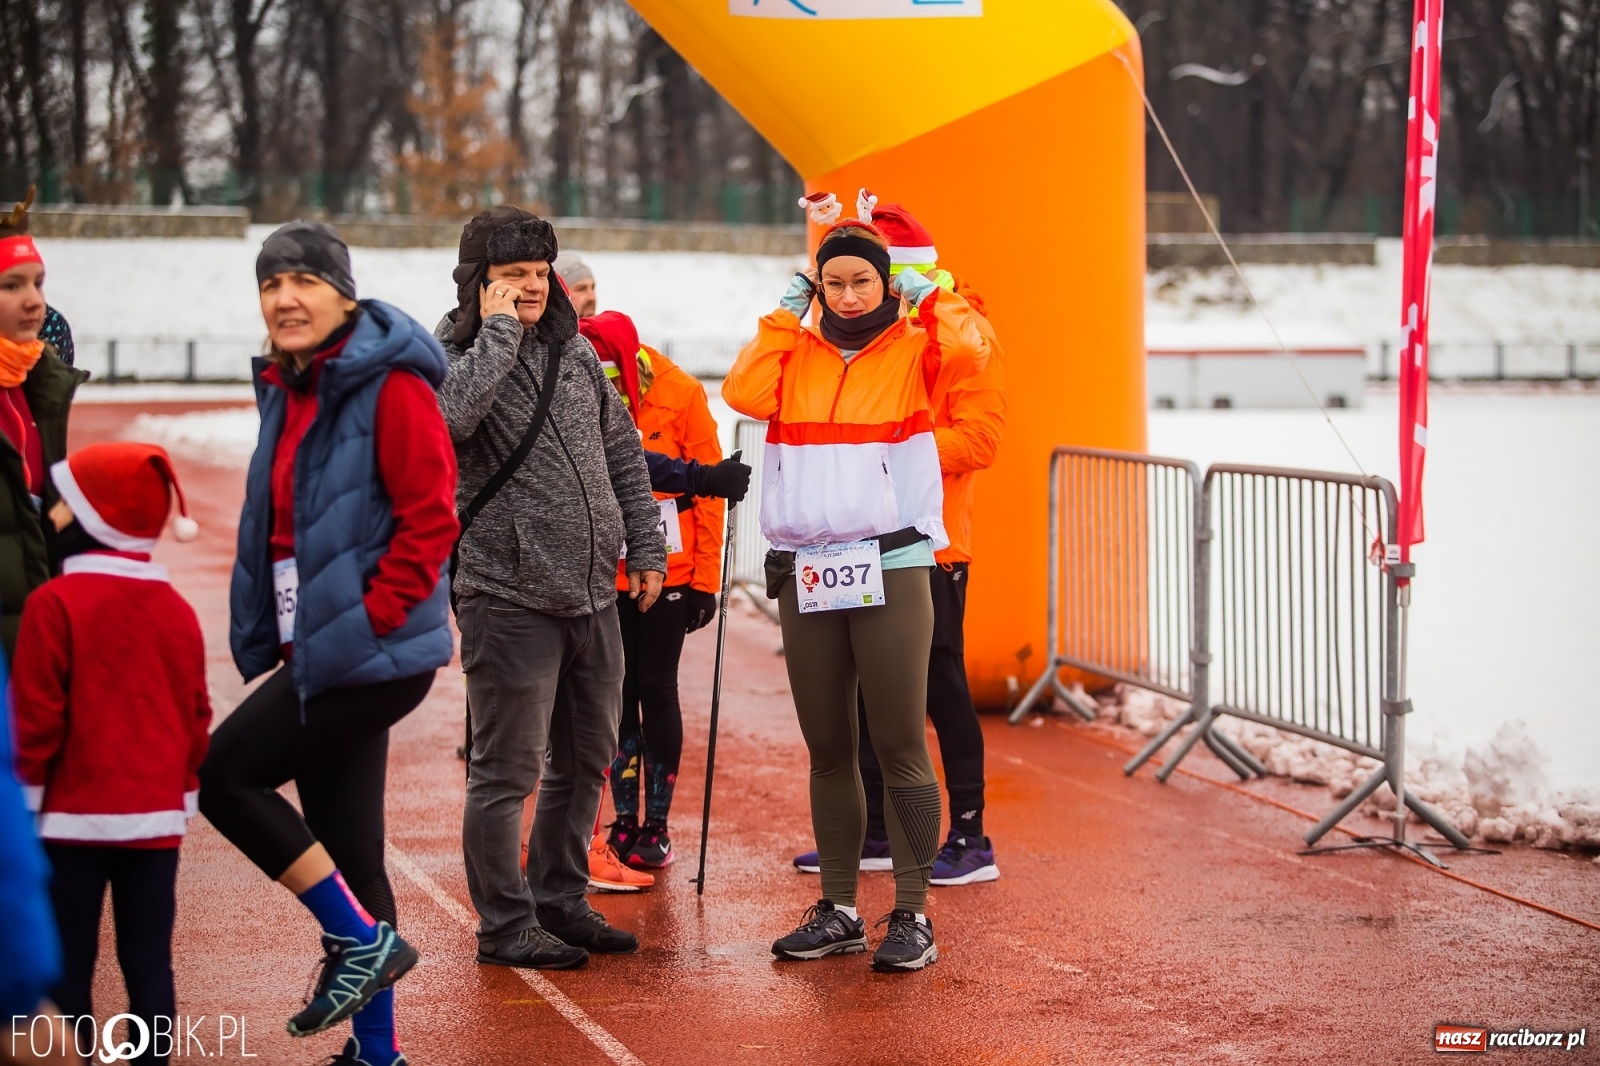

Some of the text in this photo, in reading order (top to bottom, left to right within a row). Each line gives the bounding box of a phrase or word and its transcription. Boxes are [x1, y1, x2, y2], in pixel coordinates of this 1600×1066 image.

[649, 431, 662, 440] 4F
[822, 563, 871, 589] 037
[276, 588, 295, 615] 05
